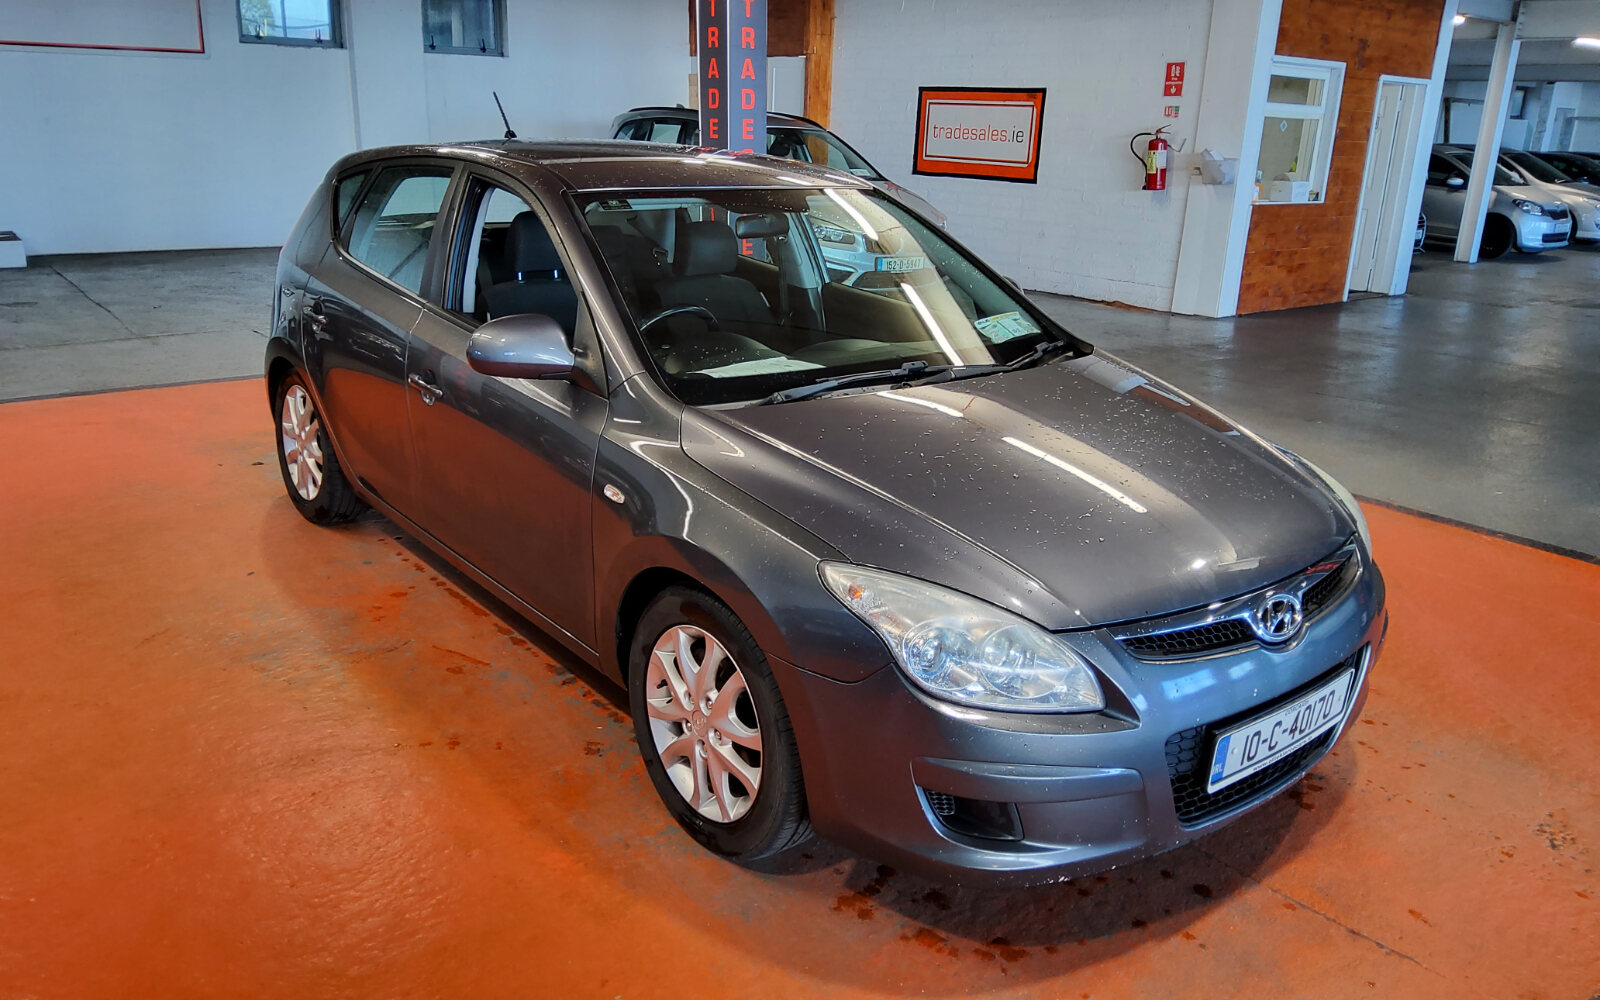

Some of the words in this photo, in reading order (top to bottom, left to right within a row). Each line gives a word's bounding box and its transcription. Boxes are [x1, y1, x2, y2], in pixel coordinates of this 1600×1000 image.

[741, 0, 756, 154] TRADE
[933, 124, 1025, 143] tradesales.ie
[1240, 689, 1336, 766] 10-C-40170
